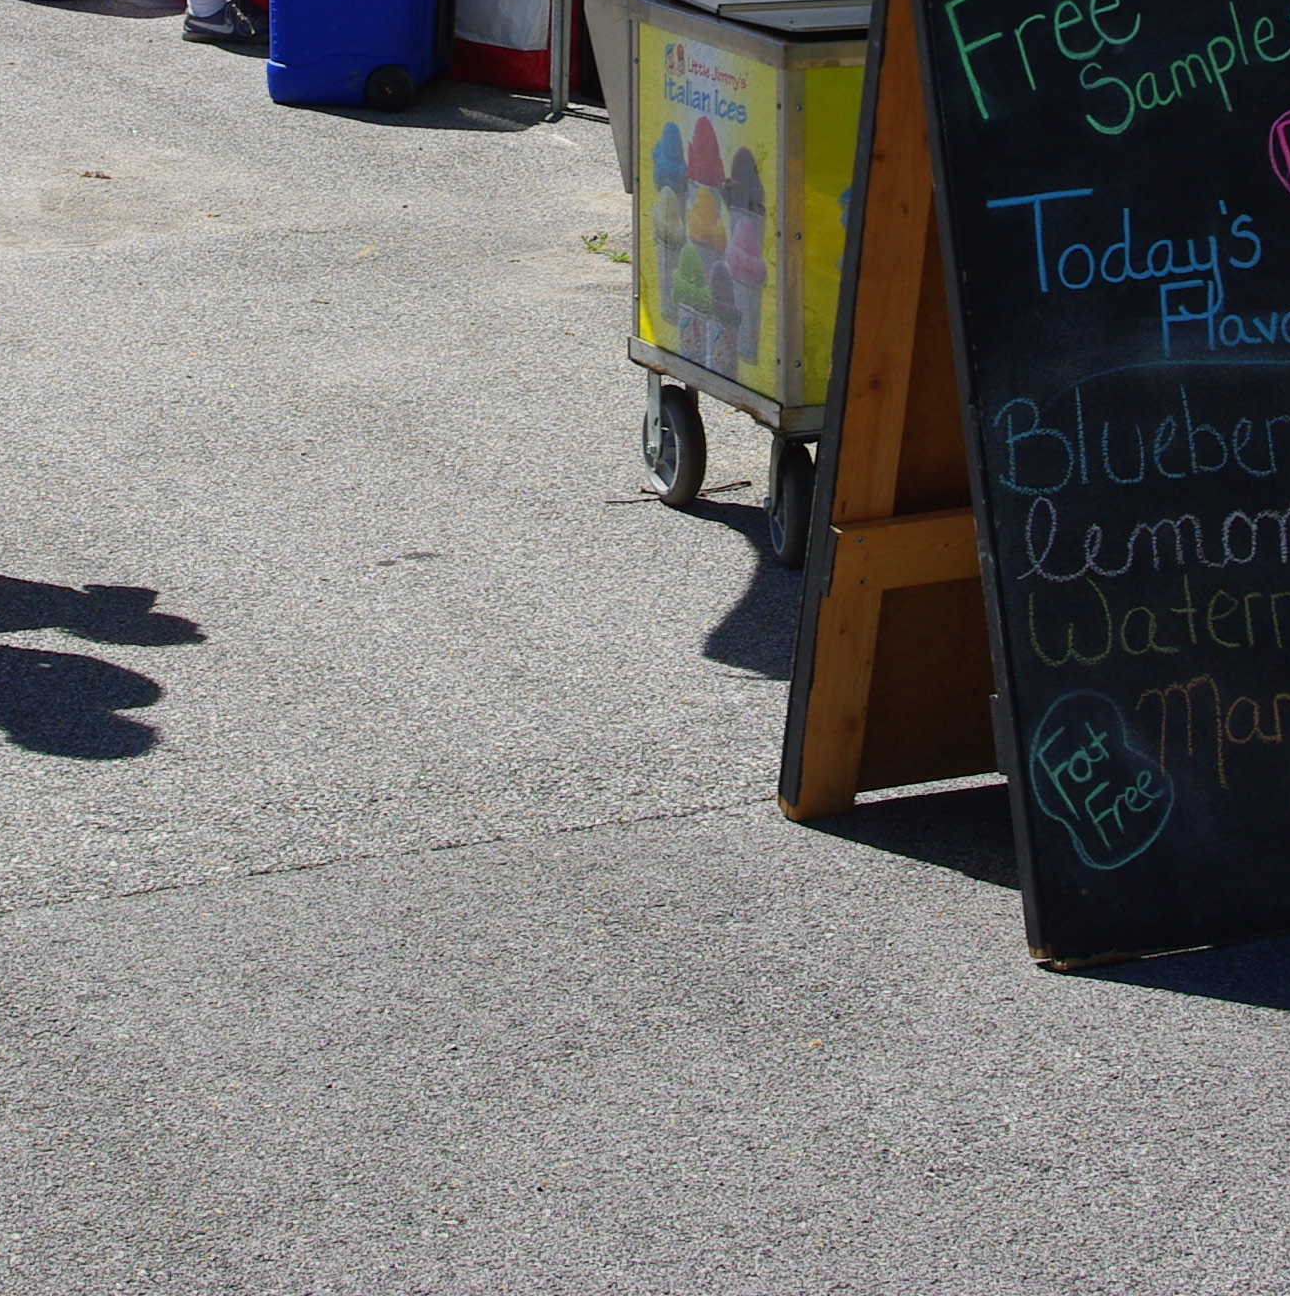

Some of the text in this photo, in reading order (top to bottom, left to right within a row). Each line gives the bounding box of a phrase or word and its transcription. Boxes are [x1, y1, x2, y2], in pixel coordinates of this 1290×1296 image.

[664, 73, 748, 125] Italian Ices
[687, 57, 712, 80] Little
[987, 188, 1262, 314] Today's
[1038, 726, 1111, 820] Fat
[1084, 770, 1163, 848] Free
